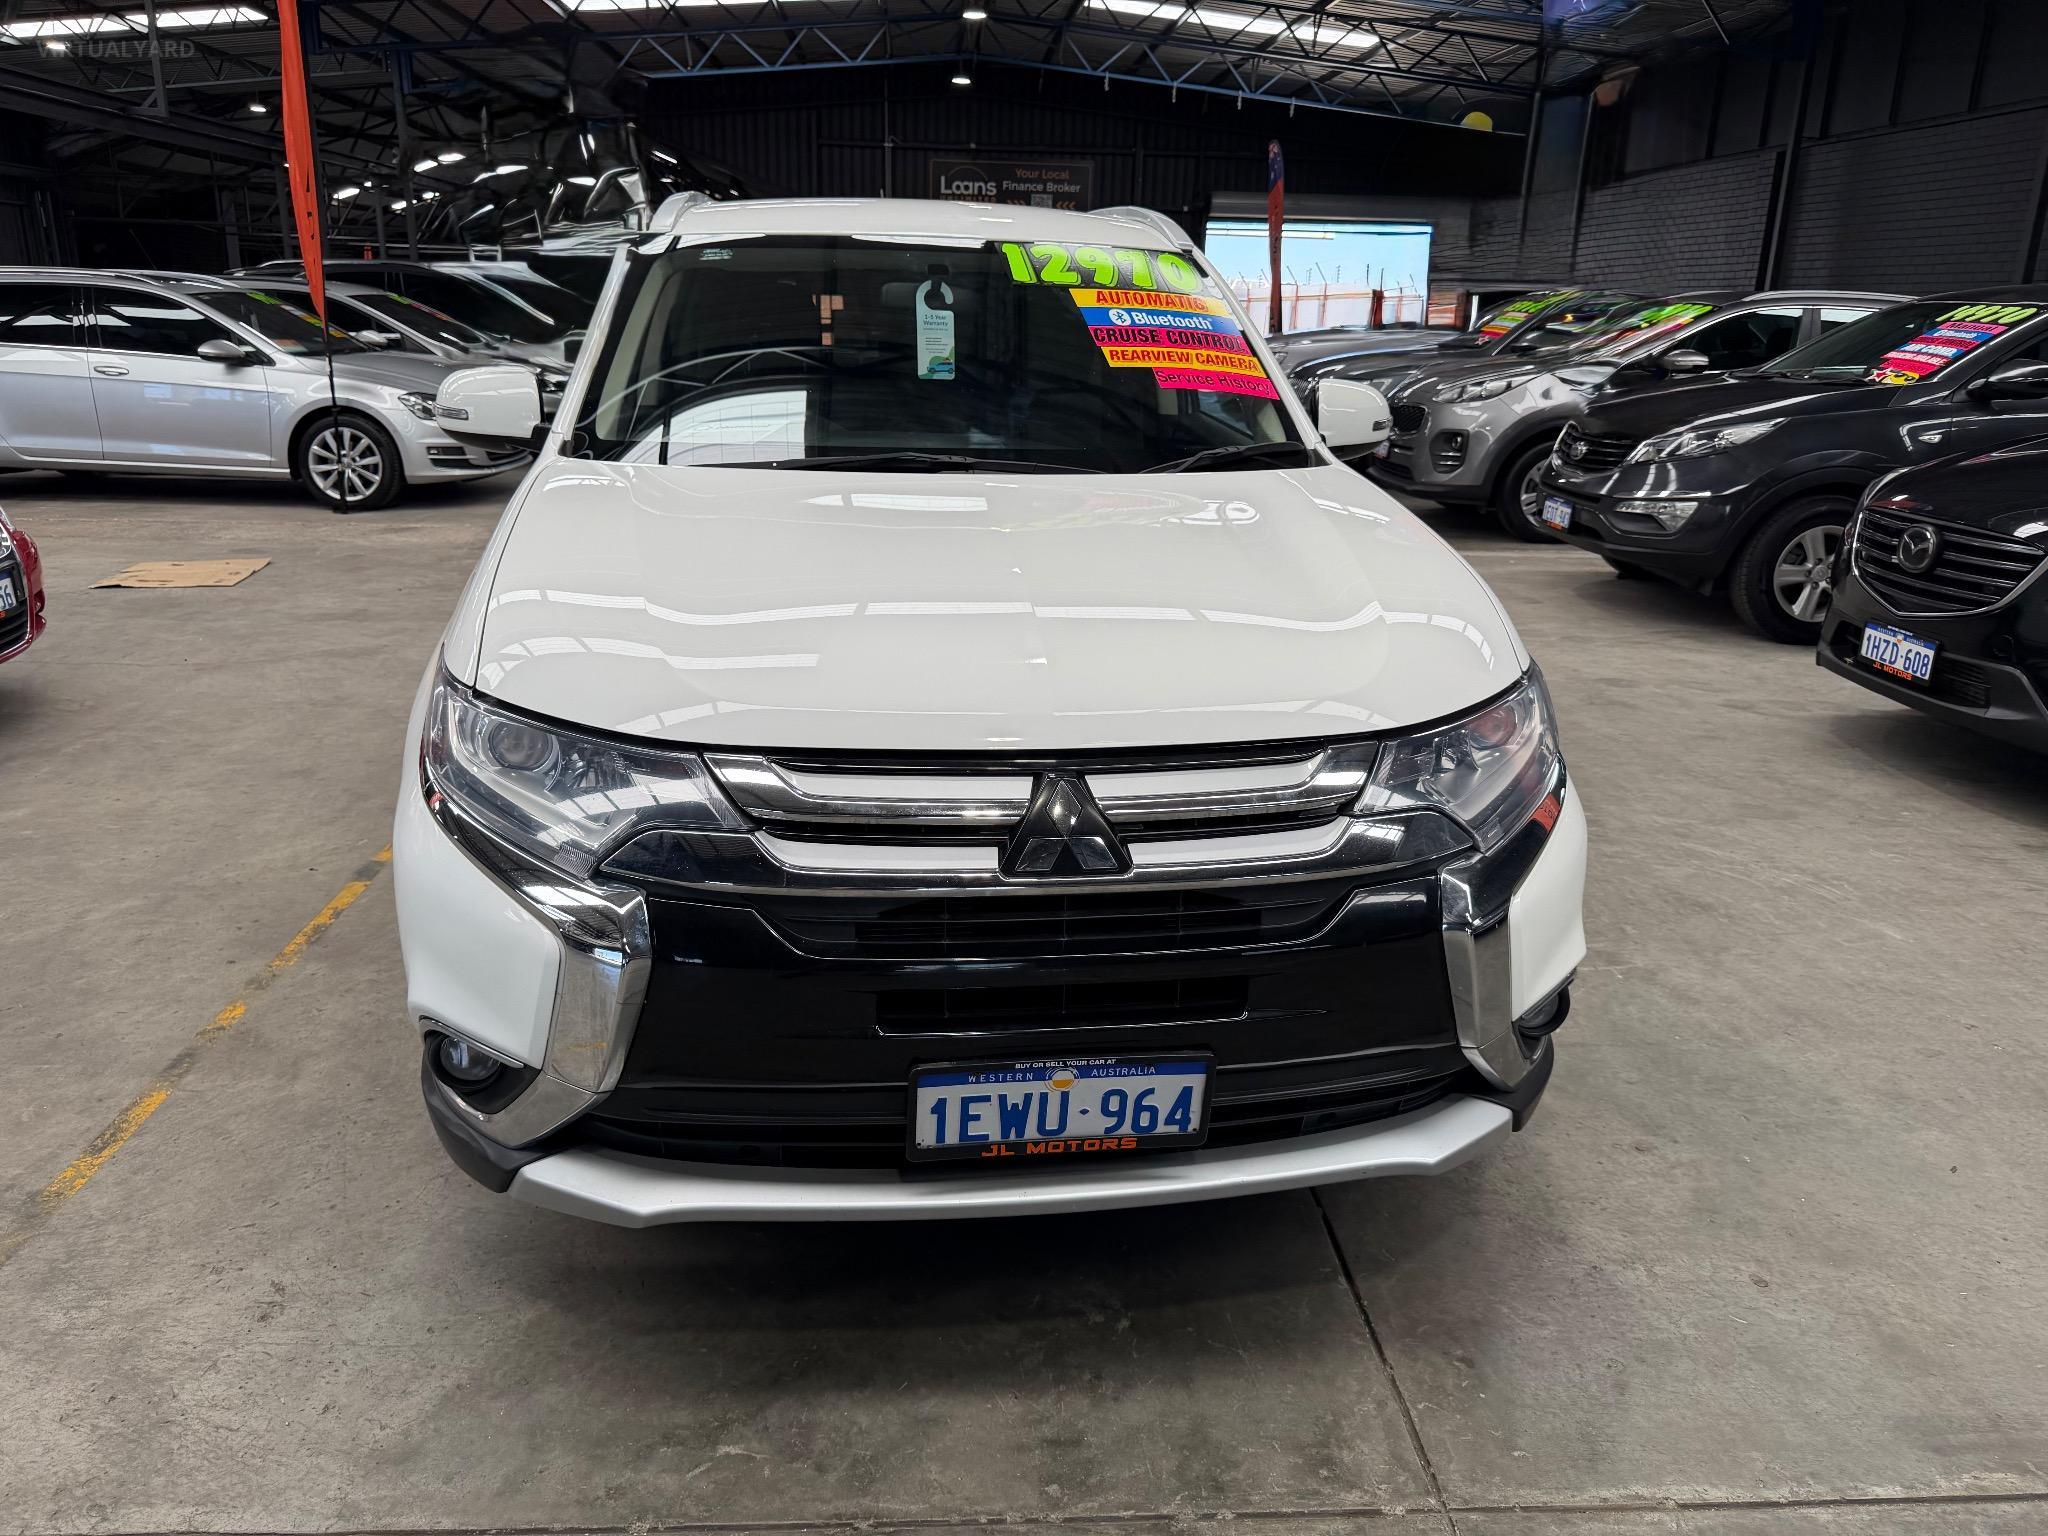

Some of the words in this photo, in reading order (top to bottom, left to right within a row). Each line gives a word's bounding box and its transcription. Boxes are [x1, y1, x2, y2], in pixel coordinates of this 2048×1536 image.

[1015, 168, 1038, 179] Your
[1042, 169, 1070, 180] Local
[940, 175, 997, 196] Loans
[1002, 181, 1044, 192] Finance
[1046, 182, 1081, 193] Broker
[1001, 243, 1202, 293] 12970
[1095, 290, 1209, 313] AUTOMATIC
[1131, 312, 1212, 330] Bluetooth
[1946, 322, 1998, 332] Manual
[1093, 326, 1161, 345] CRUISE
[1168, 330, 1245, 353] CONTROL
[1109, 349, 1190, 365] REARVIEW
[1195, 353, 1259, 372] CAMERA
[1156, 370, 1214, 387] Service
[1217, 375, 1270, 397] History
[1873, 662, 1882, 670] JL
[1884, 664, 1913, 681] MOTORS
[968, 1073, 1034, 1083] WESTERN
[1091, 1066, 1156, 1077] AUSTRALIA
[981, 1143, 1015, 1157] JL
[1026, 1137, 1138, 1155] MOTORS
